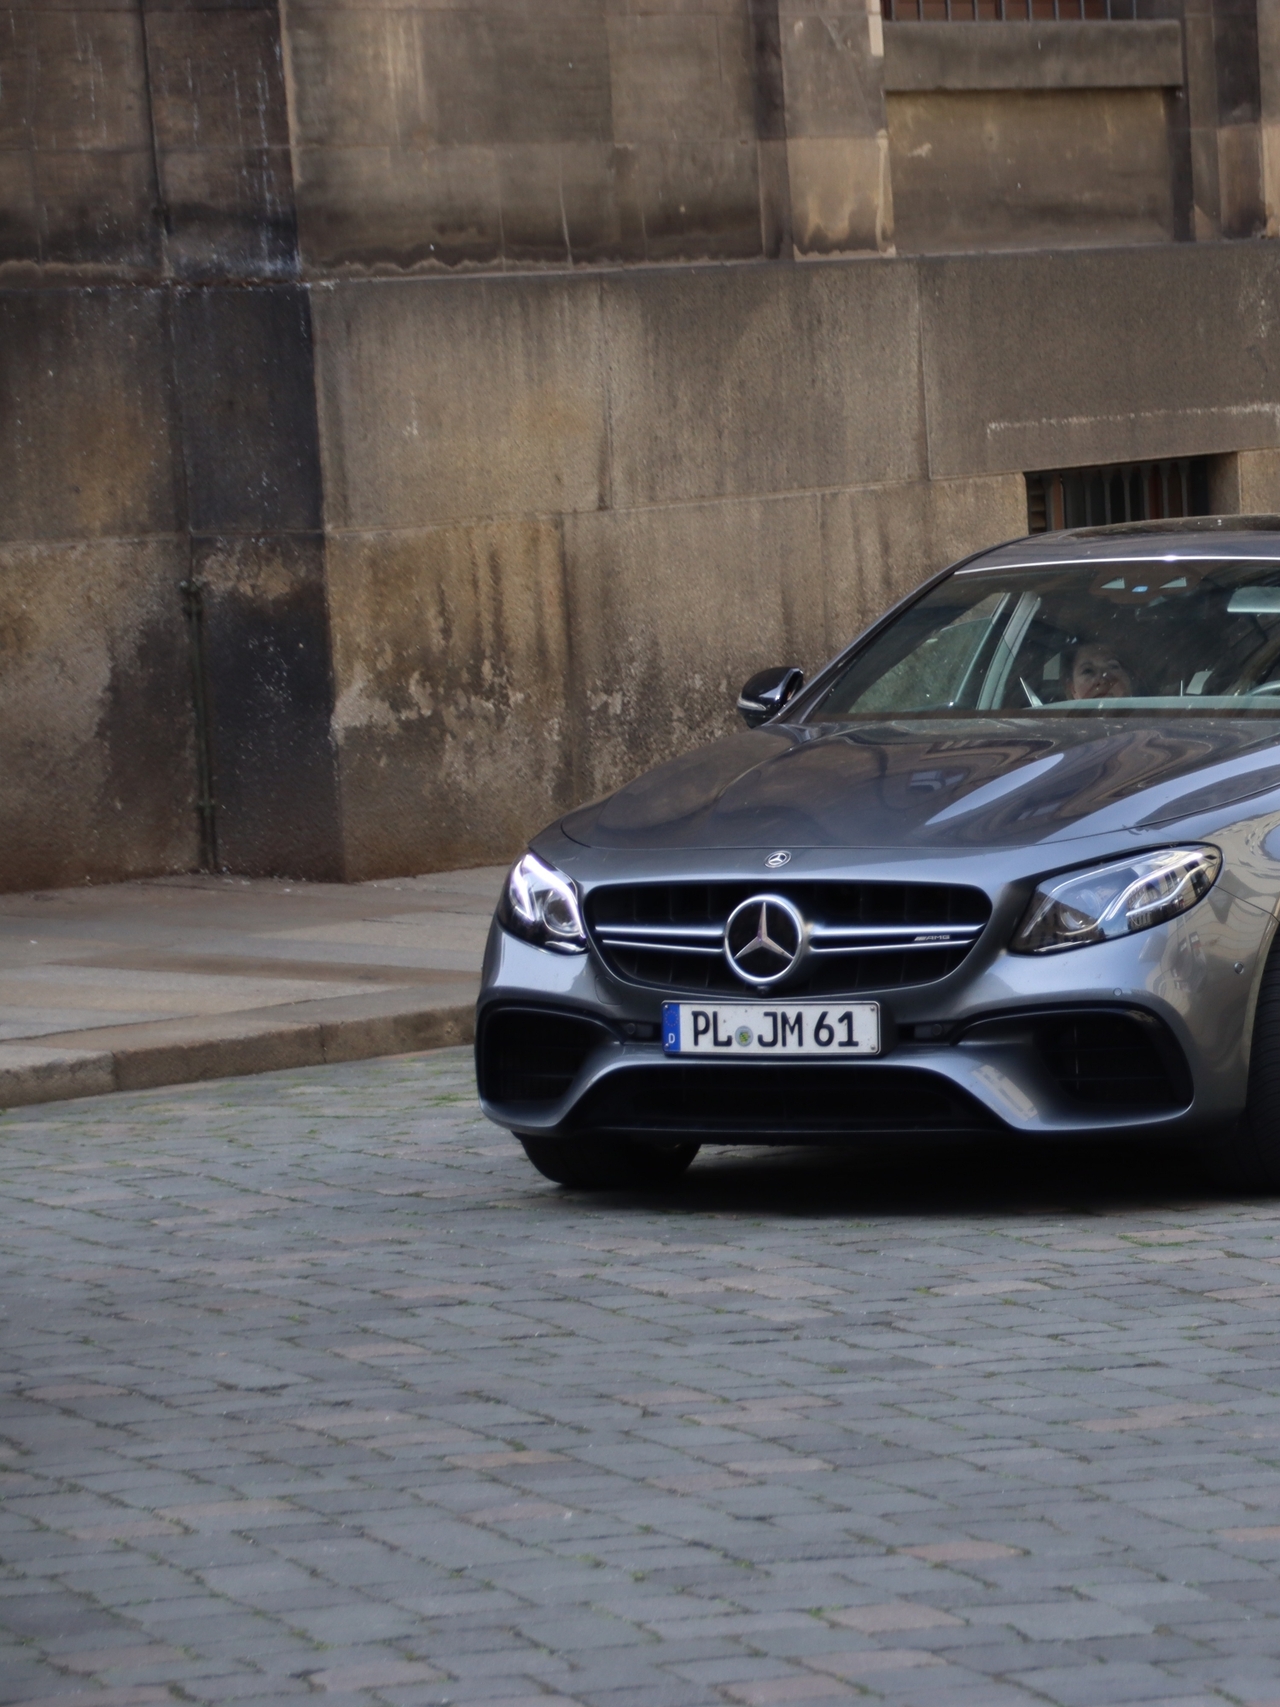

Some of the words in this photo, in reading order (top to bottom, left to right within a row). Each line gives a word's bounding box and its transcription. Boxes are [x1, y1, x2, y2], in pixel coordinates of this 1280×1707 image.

[668, 1033, 676, 1044] D
[691, 1010, 733, 1047] PL
[757, 1010, 804, 1047] JM
[813, 1010, 859, 1047] 61
